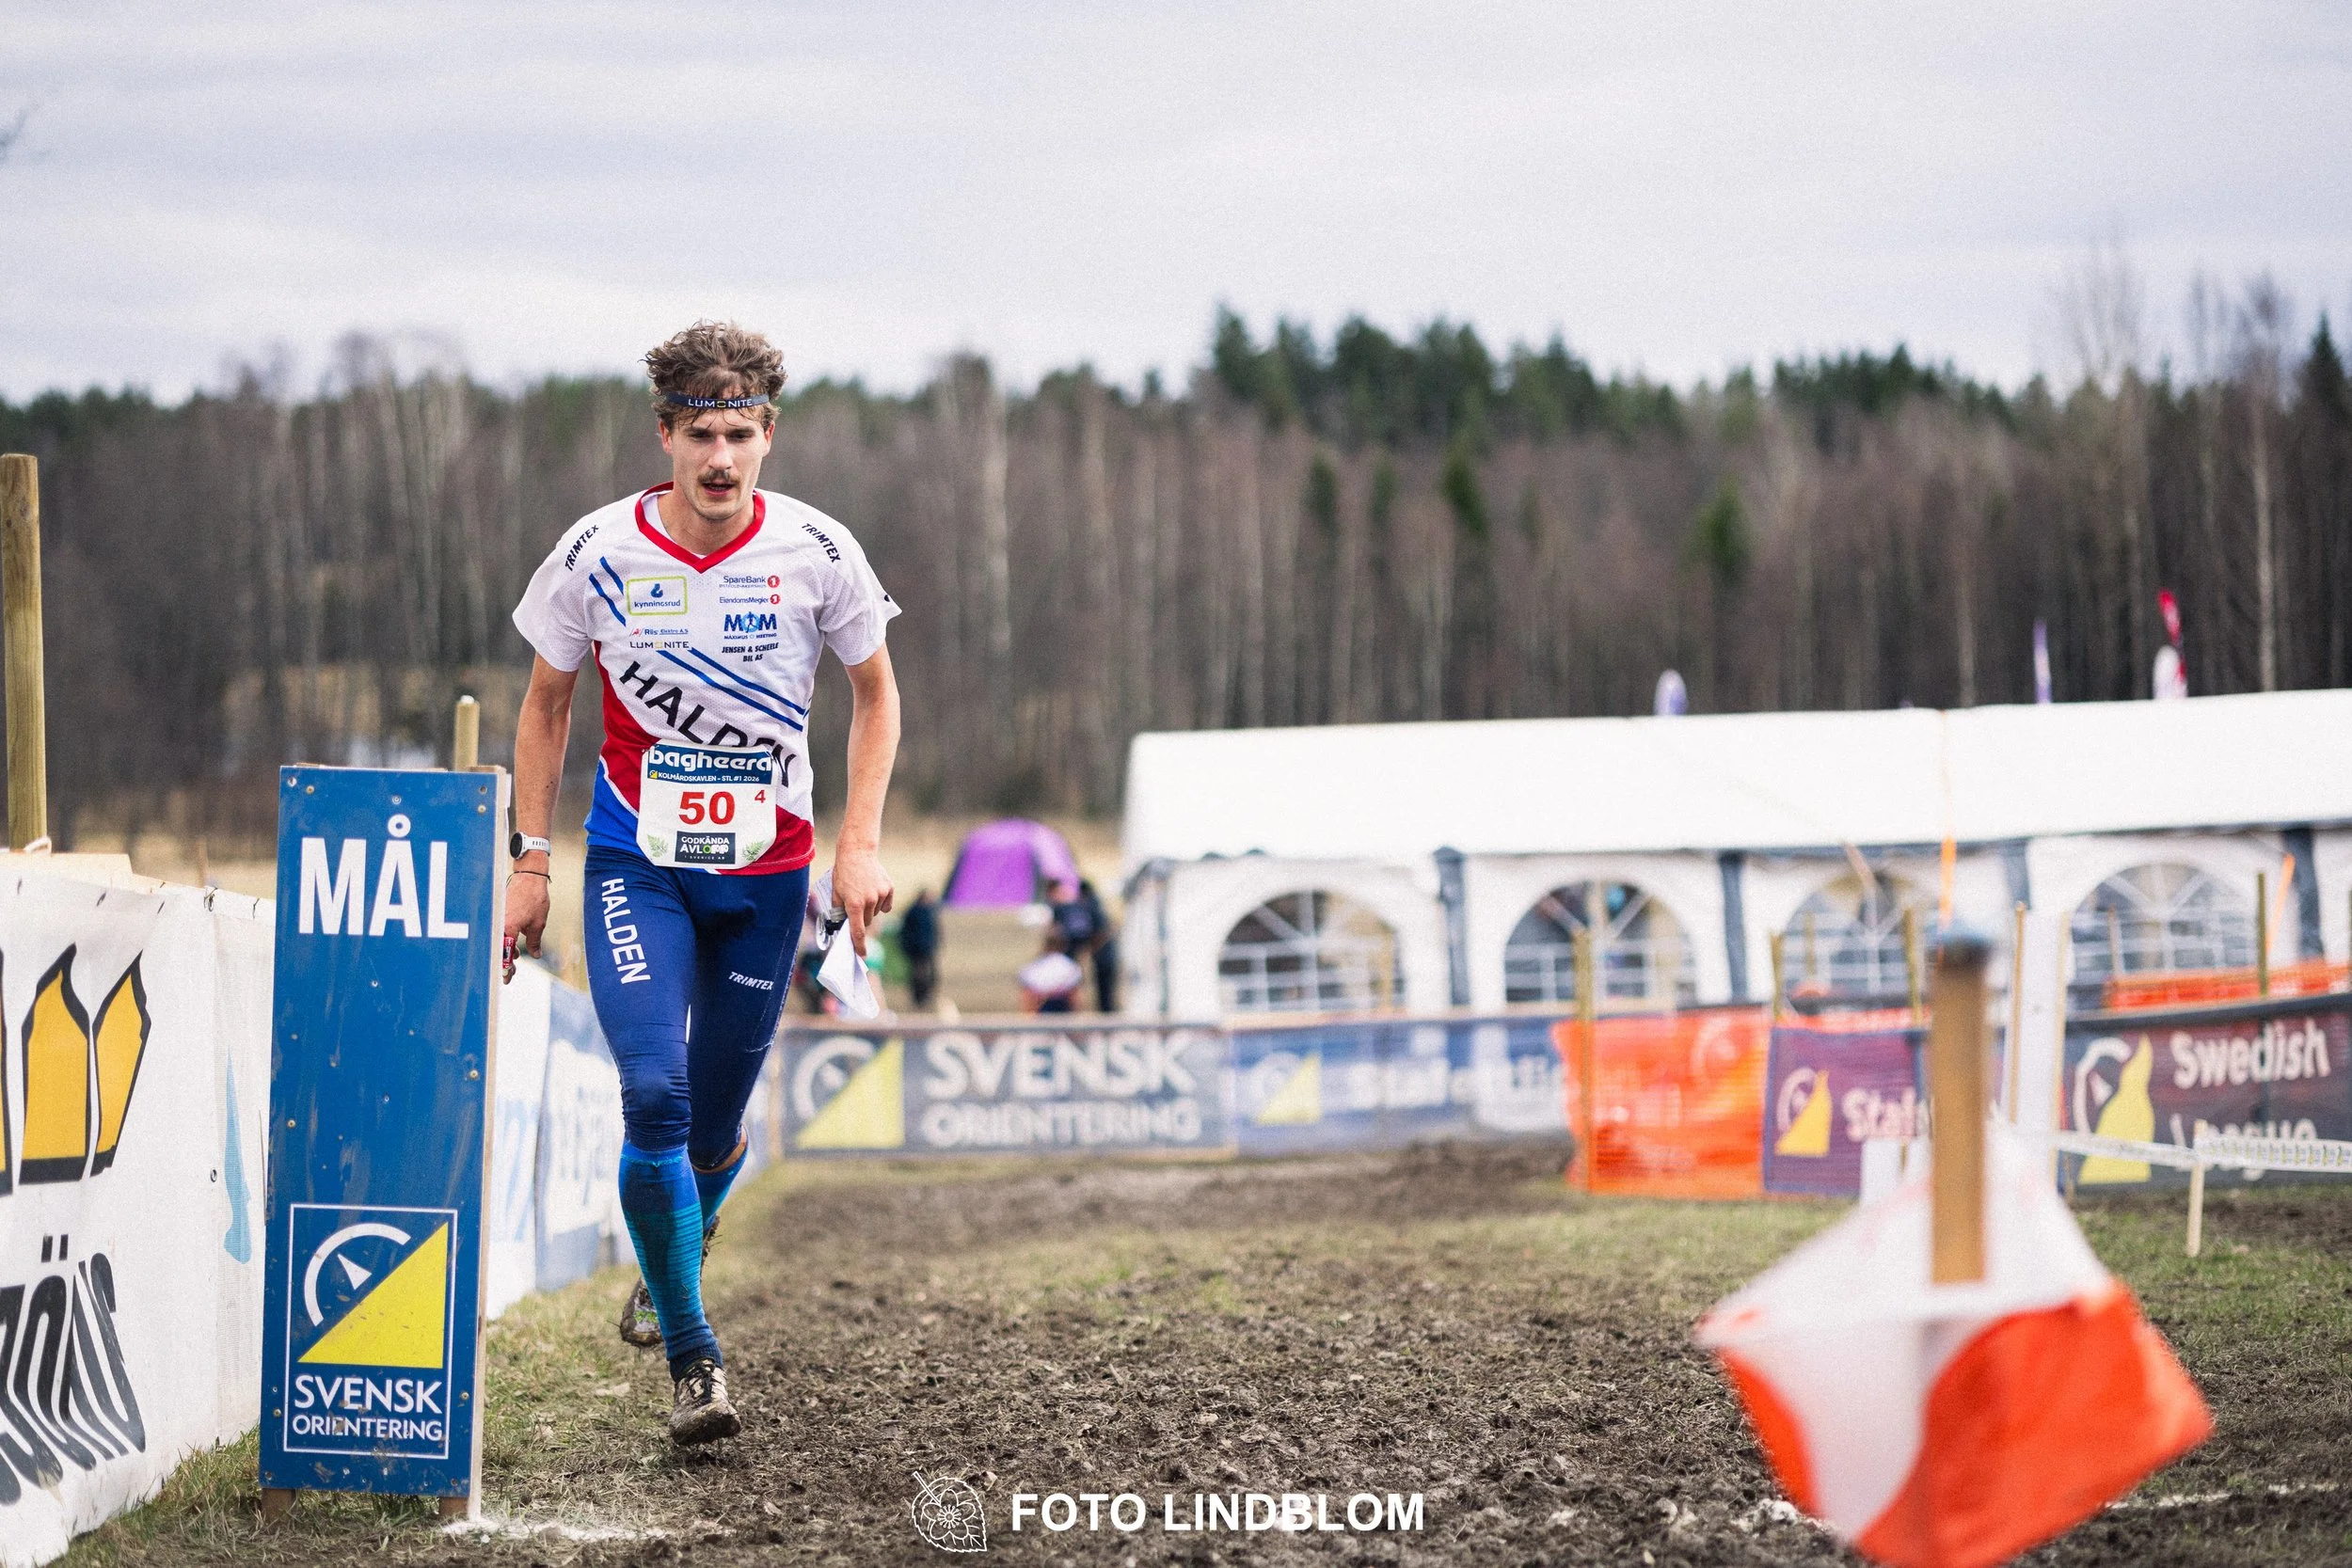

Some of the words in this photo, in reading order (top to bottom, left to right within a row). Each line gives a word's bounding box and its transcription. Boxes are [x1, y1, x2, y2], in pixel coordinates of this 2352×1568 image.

[564, 525, 599, 572] TRIMTEX
[802, 523, 841, 563] TRIMTEX
[723, 575, 766, 584] SpareBank
[634, 599, 681, 609] kynningsrud
[722, 645, 746, 654] JENSEN
[649, 745, 771, 771] bagheera
[659, 772, 717, 782] KOLMÅRDSKAVLEN
[678, 791, 736, 825] 50
[754, 789, 767, 803] 4
[681, 835, 730, 845] GODKÄNDA
[298, 814, 470, 939] MÅL
[601, 878, 651, 985] HALDEN
[728, 972, 775, 990] TRIMTEX
[923, 1030, 1199, 1100] SVENSK
[2169, 1015, 2331, 1089] Swedish
[920, 1097, 1202, 1148] ORIENTERING
[294, 1374, 443, 1414] SVENSK
[292, 1414, 443, 1443] ORIENTERING
